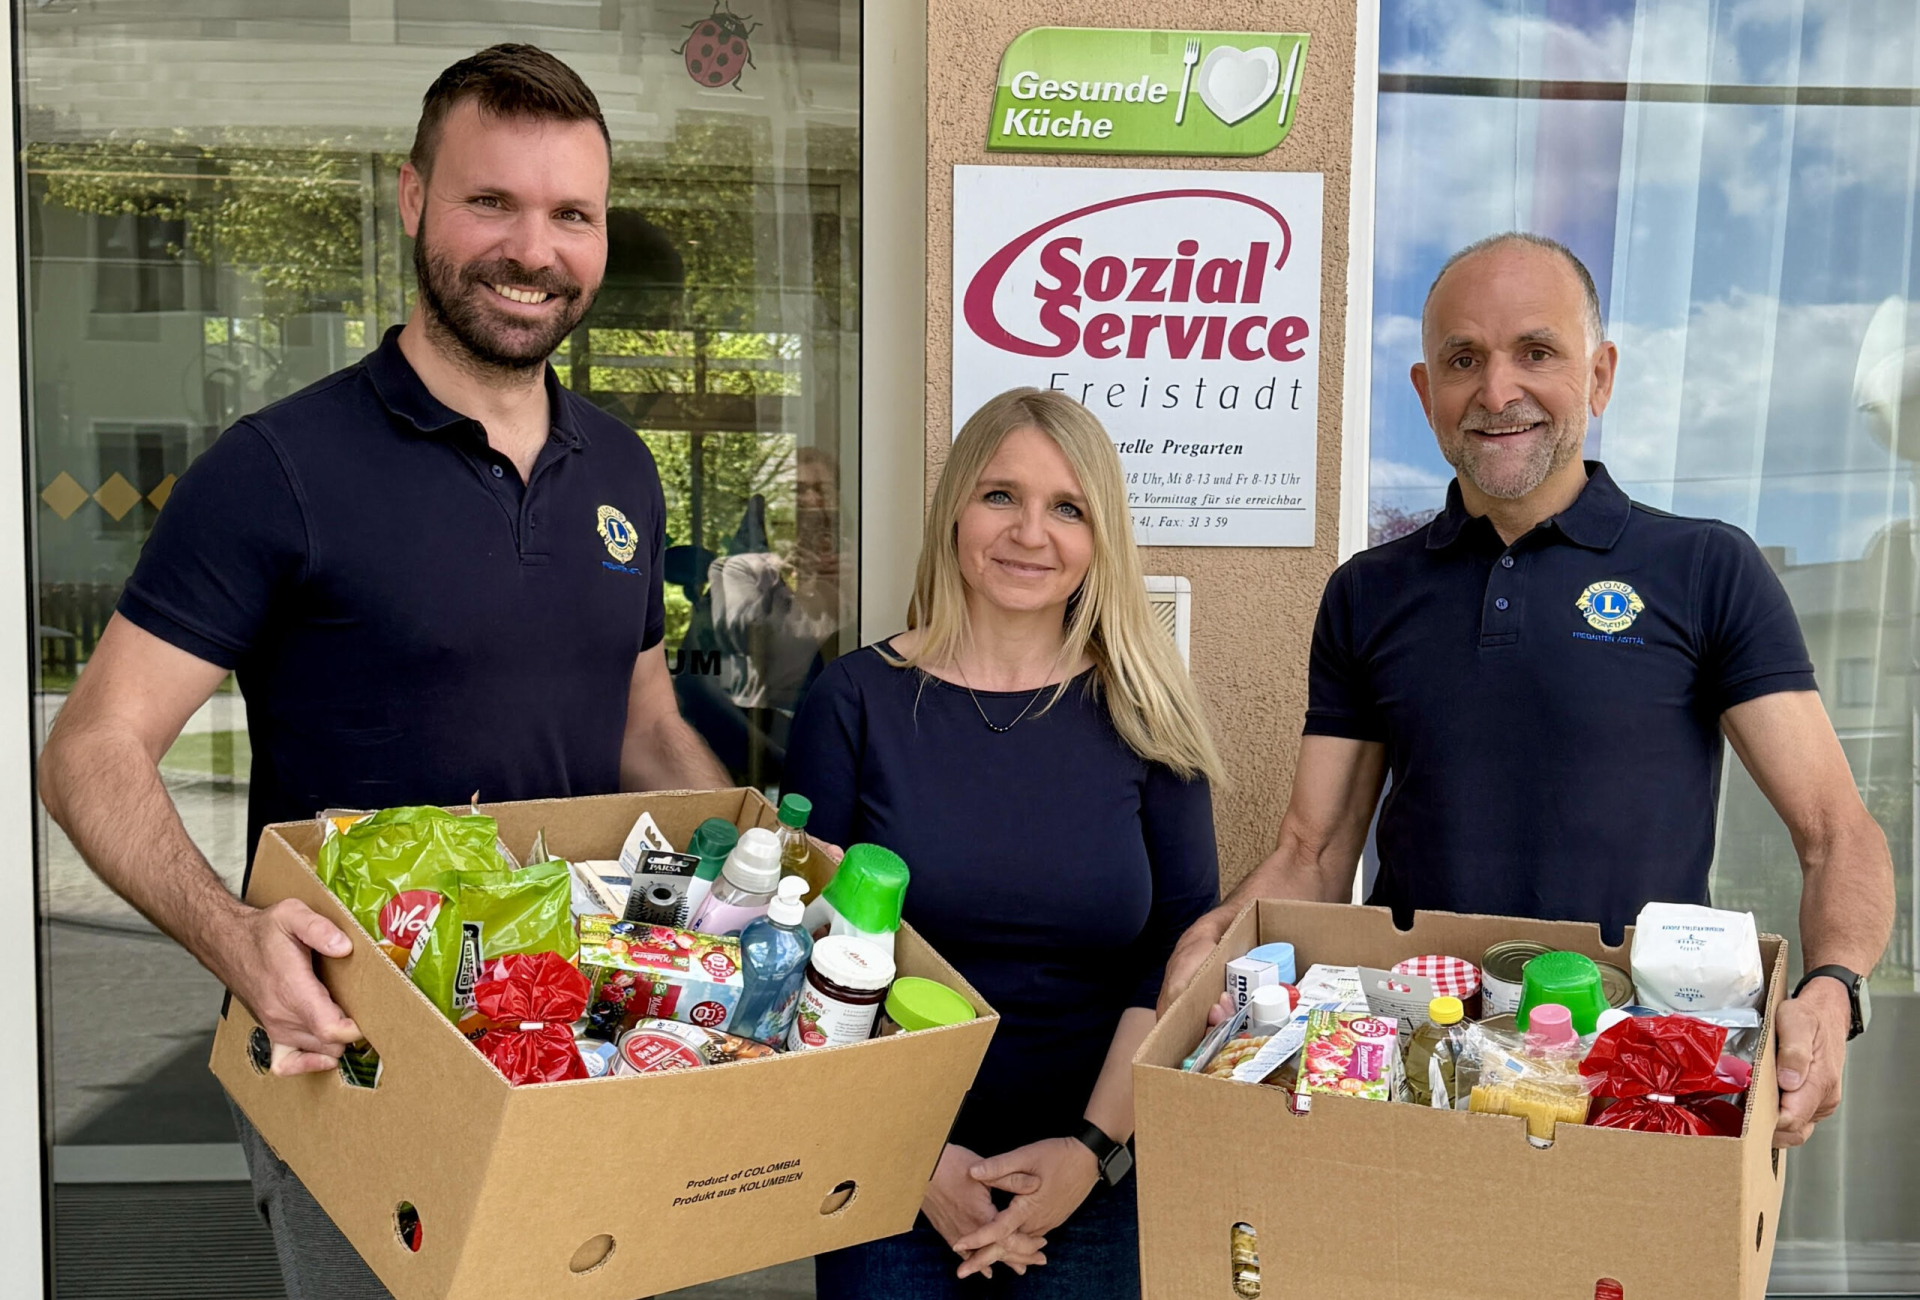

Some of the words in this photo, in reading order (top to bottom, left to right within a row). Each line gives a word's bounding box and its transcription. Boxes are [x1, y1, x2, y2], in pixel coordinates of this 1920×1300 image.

[1010, 71, 1167, 103] Gesunde
[1002, 108, 1113, 138] Küche
[1034, 237, 1270, 304] Sozial
[1039, 296, 1309, 362] Service
[1050, 373, 1302, 410] Freistadt
[1162, 440, 1243, 457] Pregarten
[1214, 473, 1232, 485] und
[1236, 473, 1249, 485] Fr
[1281, 473, 1302, 486] Uhr
[1128, 492, 1139, 504] Fr
[1144, 493, 1198, 506] Vormittag
[1201, 493, 1220, 506] für
[1225, 494, 1241, 505] sie
[1246, 494, 1303, 506] erreichbar
[610, 521, 627, 544] L
[1158, 516, 1184, 528] Fax:
[1204, 516, 1210, 528] 3
[1215, 516, 1228, 528] 59
[1591, 582, 1630, 593] LIONS
[1602, 595, 1621, 613] L
[649, 863, 681, 873] PARSA
[686, 1174, 729, 1189] Product
[730, 1170, 744, 1181] of
[743, 1158, 801, 1178] COLOMBIA
[672, 1191, 716, 1207] Produkt
[717, 1187, 737, 1198] aus
[738, 1172, 804, 1193] KOLUMBIEN
